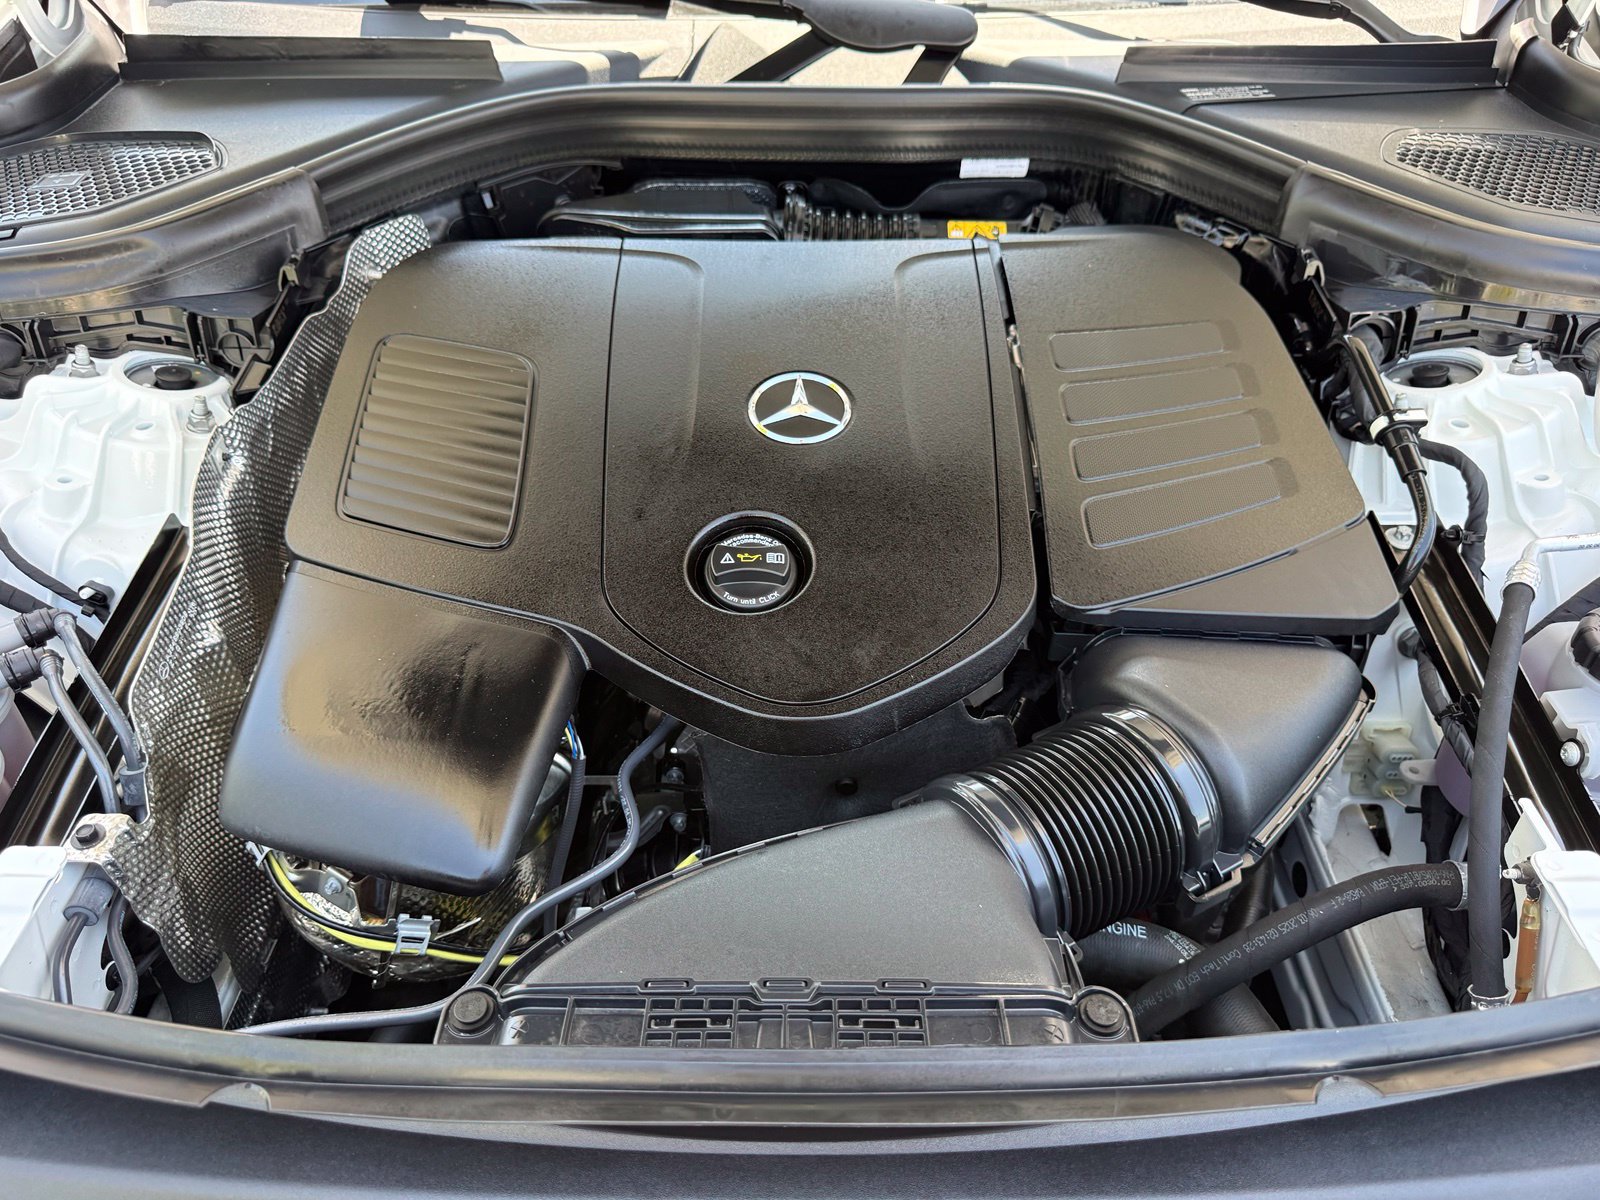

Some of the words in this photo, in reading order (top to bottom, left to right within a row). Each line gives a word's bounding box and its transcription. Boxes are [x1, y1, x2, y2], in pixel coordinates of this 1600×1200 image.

[721, 533, 772, 546] Mercedes-Benz
[723, 591, 738, 602] Turn
[740, 597, 756, 605] until
[759, 591, 781, 603] CLICK
[1099, 921, 1148, 939] NGINE
[1243, 928, 1279, 954] 02:43:28
[1200, 949, 1242, 975] ContiTech
